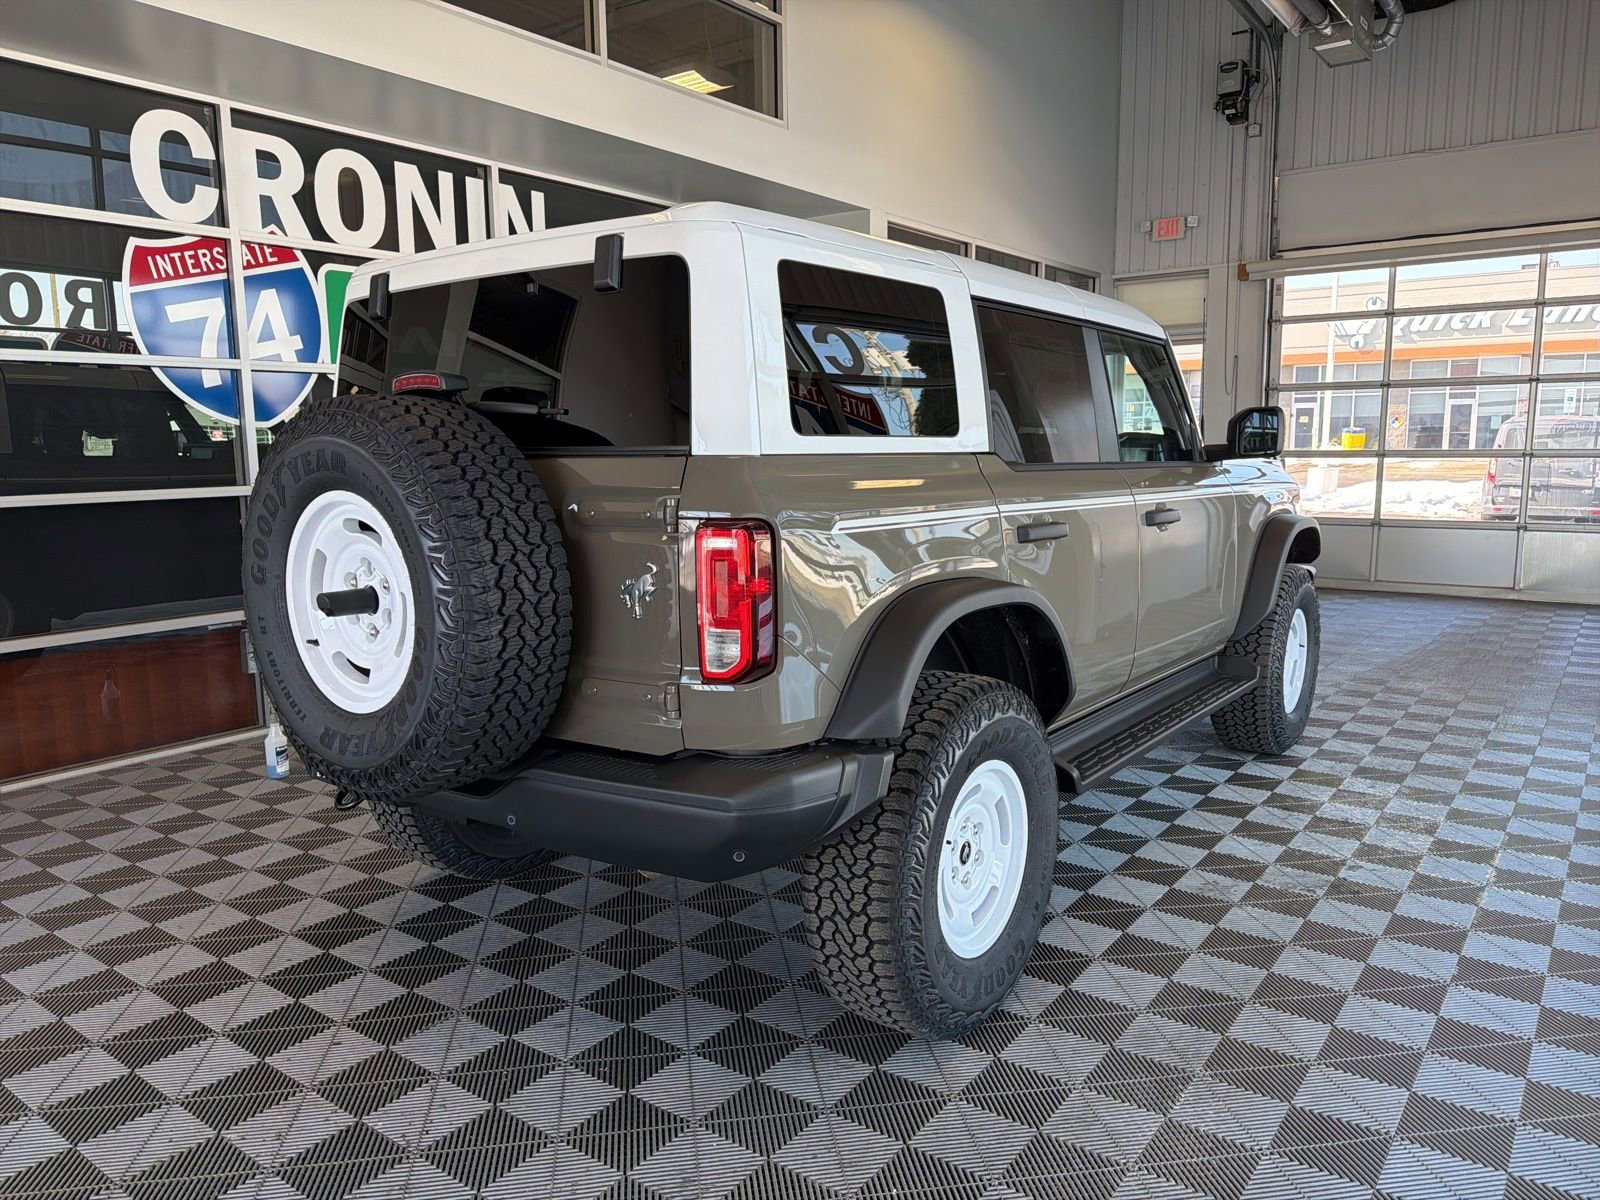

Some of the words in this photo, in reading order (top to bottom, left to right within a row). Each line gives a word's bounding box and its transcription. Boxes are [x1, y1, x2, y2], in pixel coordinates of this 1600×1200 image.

[130, 109, 546, 254] CRONIN
[147, 243, 278, 279] INTERSATE
[1156, 216, 1182, 239] EXIT
[165, 288, 304, 388] 74
[265, 650, 308, 724] TERRITORY
